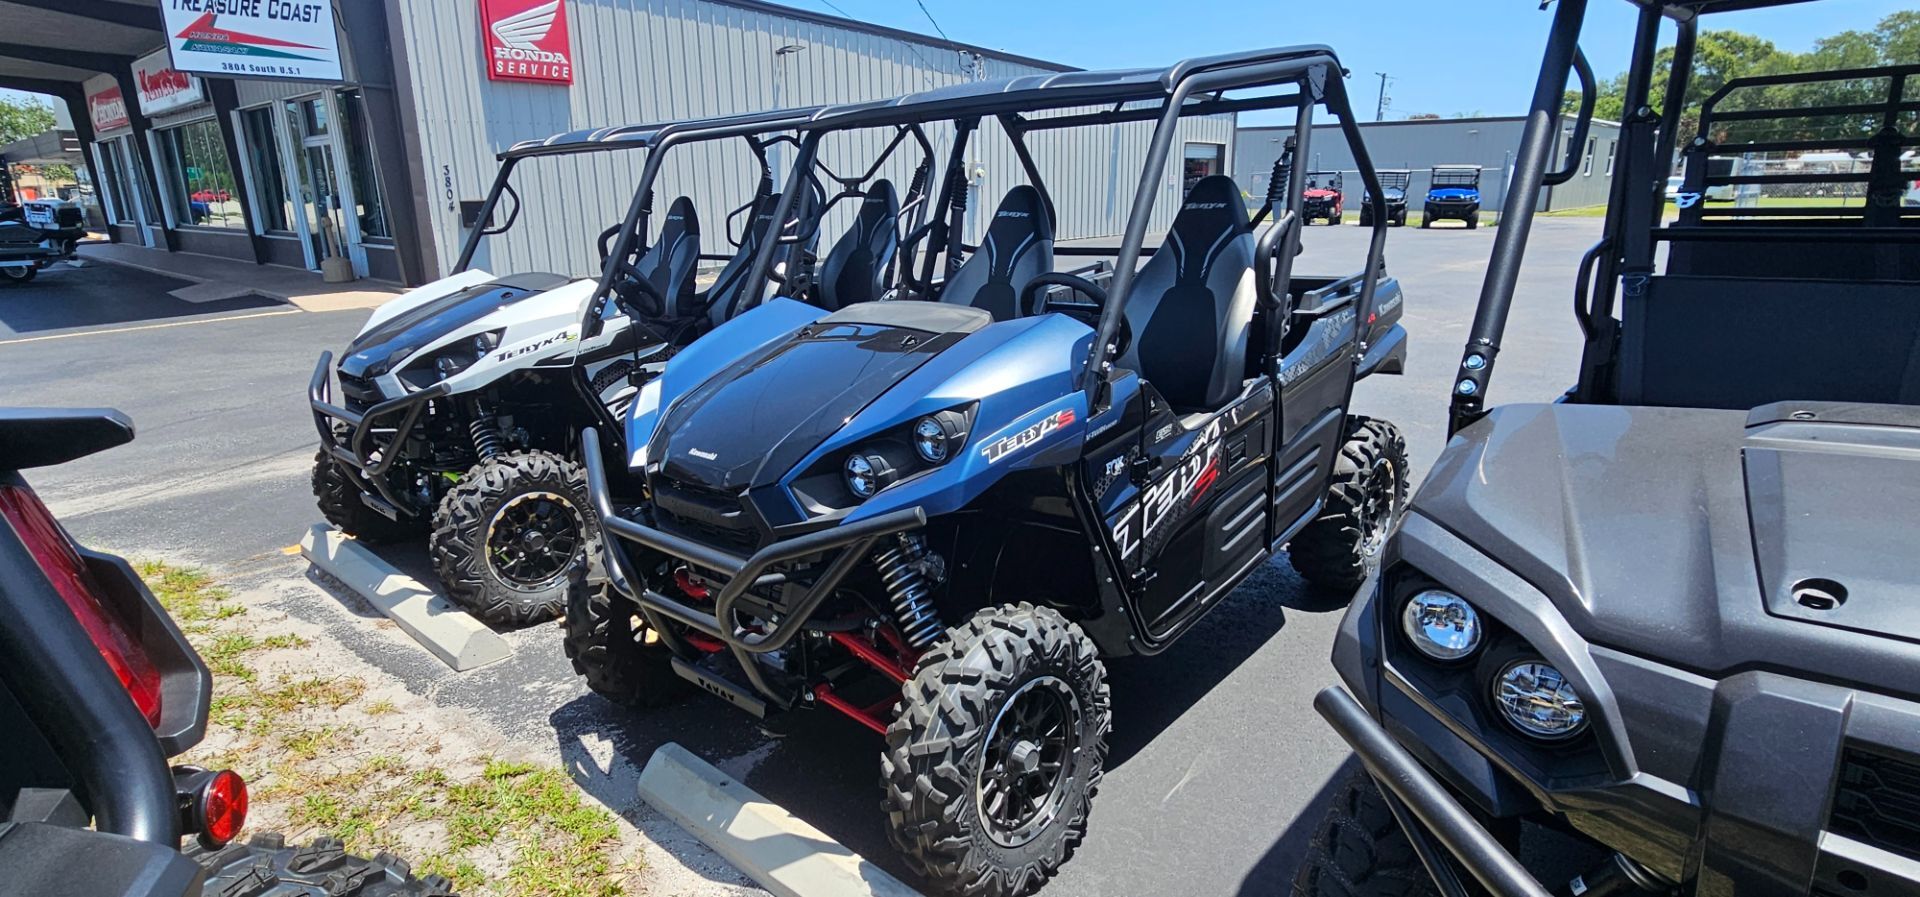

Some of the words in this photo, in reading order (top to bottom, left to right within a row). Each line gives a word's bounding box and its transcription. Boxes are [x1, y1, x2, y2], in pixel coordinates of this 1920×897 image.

[267, 0, 322, 24] COAST
[493, 46, 568, 64] HONDA
[221, 62, 246, 71] 3804
[249, 64, 276, 74] South
[280, 66, 301, 75] U.S.1
[496, 60, 570, 78] SERVICE
[442, 164, 455, 212] 3804
[1105, 455, 1125, 477] FOX
